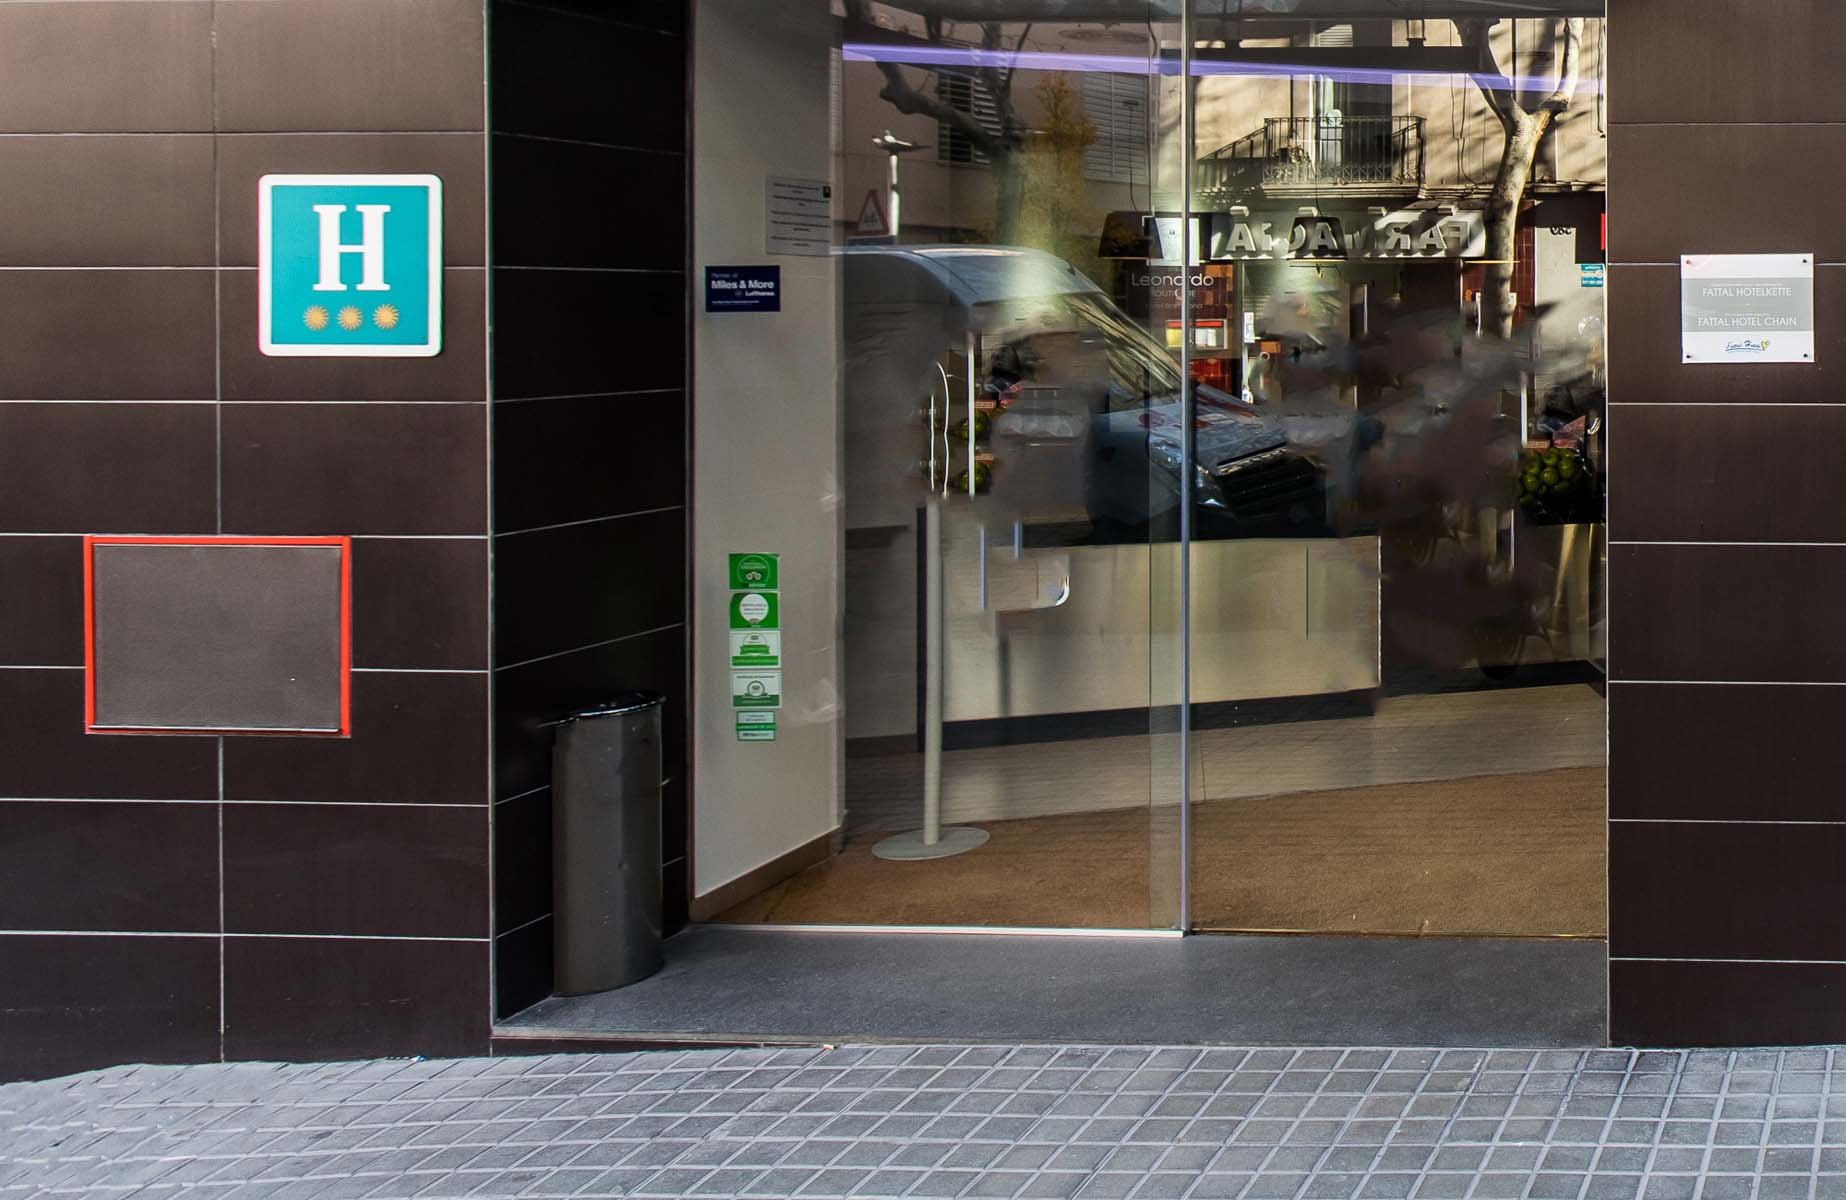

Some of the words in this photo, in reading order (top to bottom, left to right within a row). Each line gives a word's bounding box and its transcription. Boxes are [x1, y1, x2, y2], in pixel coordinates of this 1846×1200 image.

[312, 203, 392, 292] H
[711, 280, 738, 289] Miles
[739, 280, 747, 289] &
[748, 280, 775, 289] More
[1130, 272, 1215, 287] Leonado
[1702, 287, 1734, 297] FATTAL
[1736, 287, 1792, 297] HOTELKETTE
[1697, 316, 1730, 328] FATTAL
[1731, 316, 1762, 327] HOTEL
[1764, 316, 1798, 327] CHAIN
